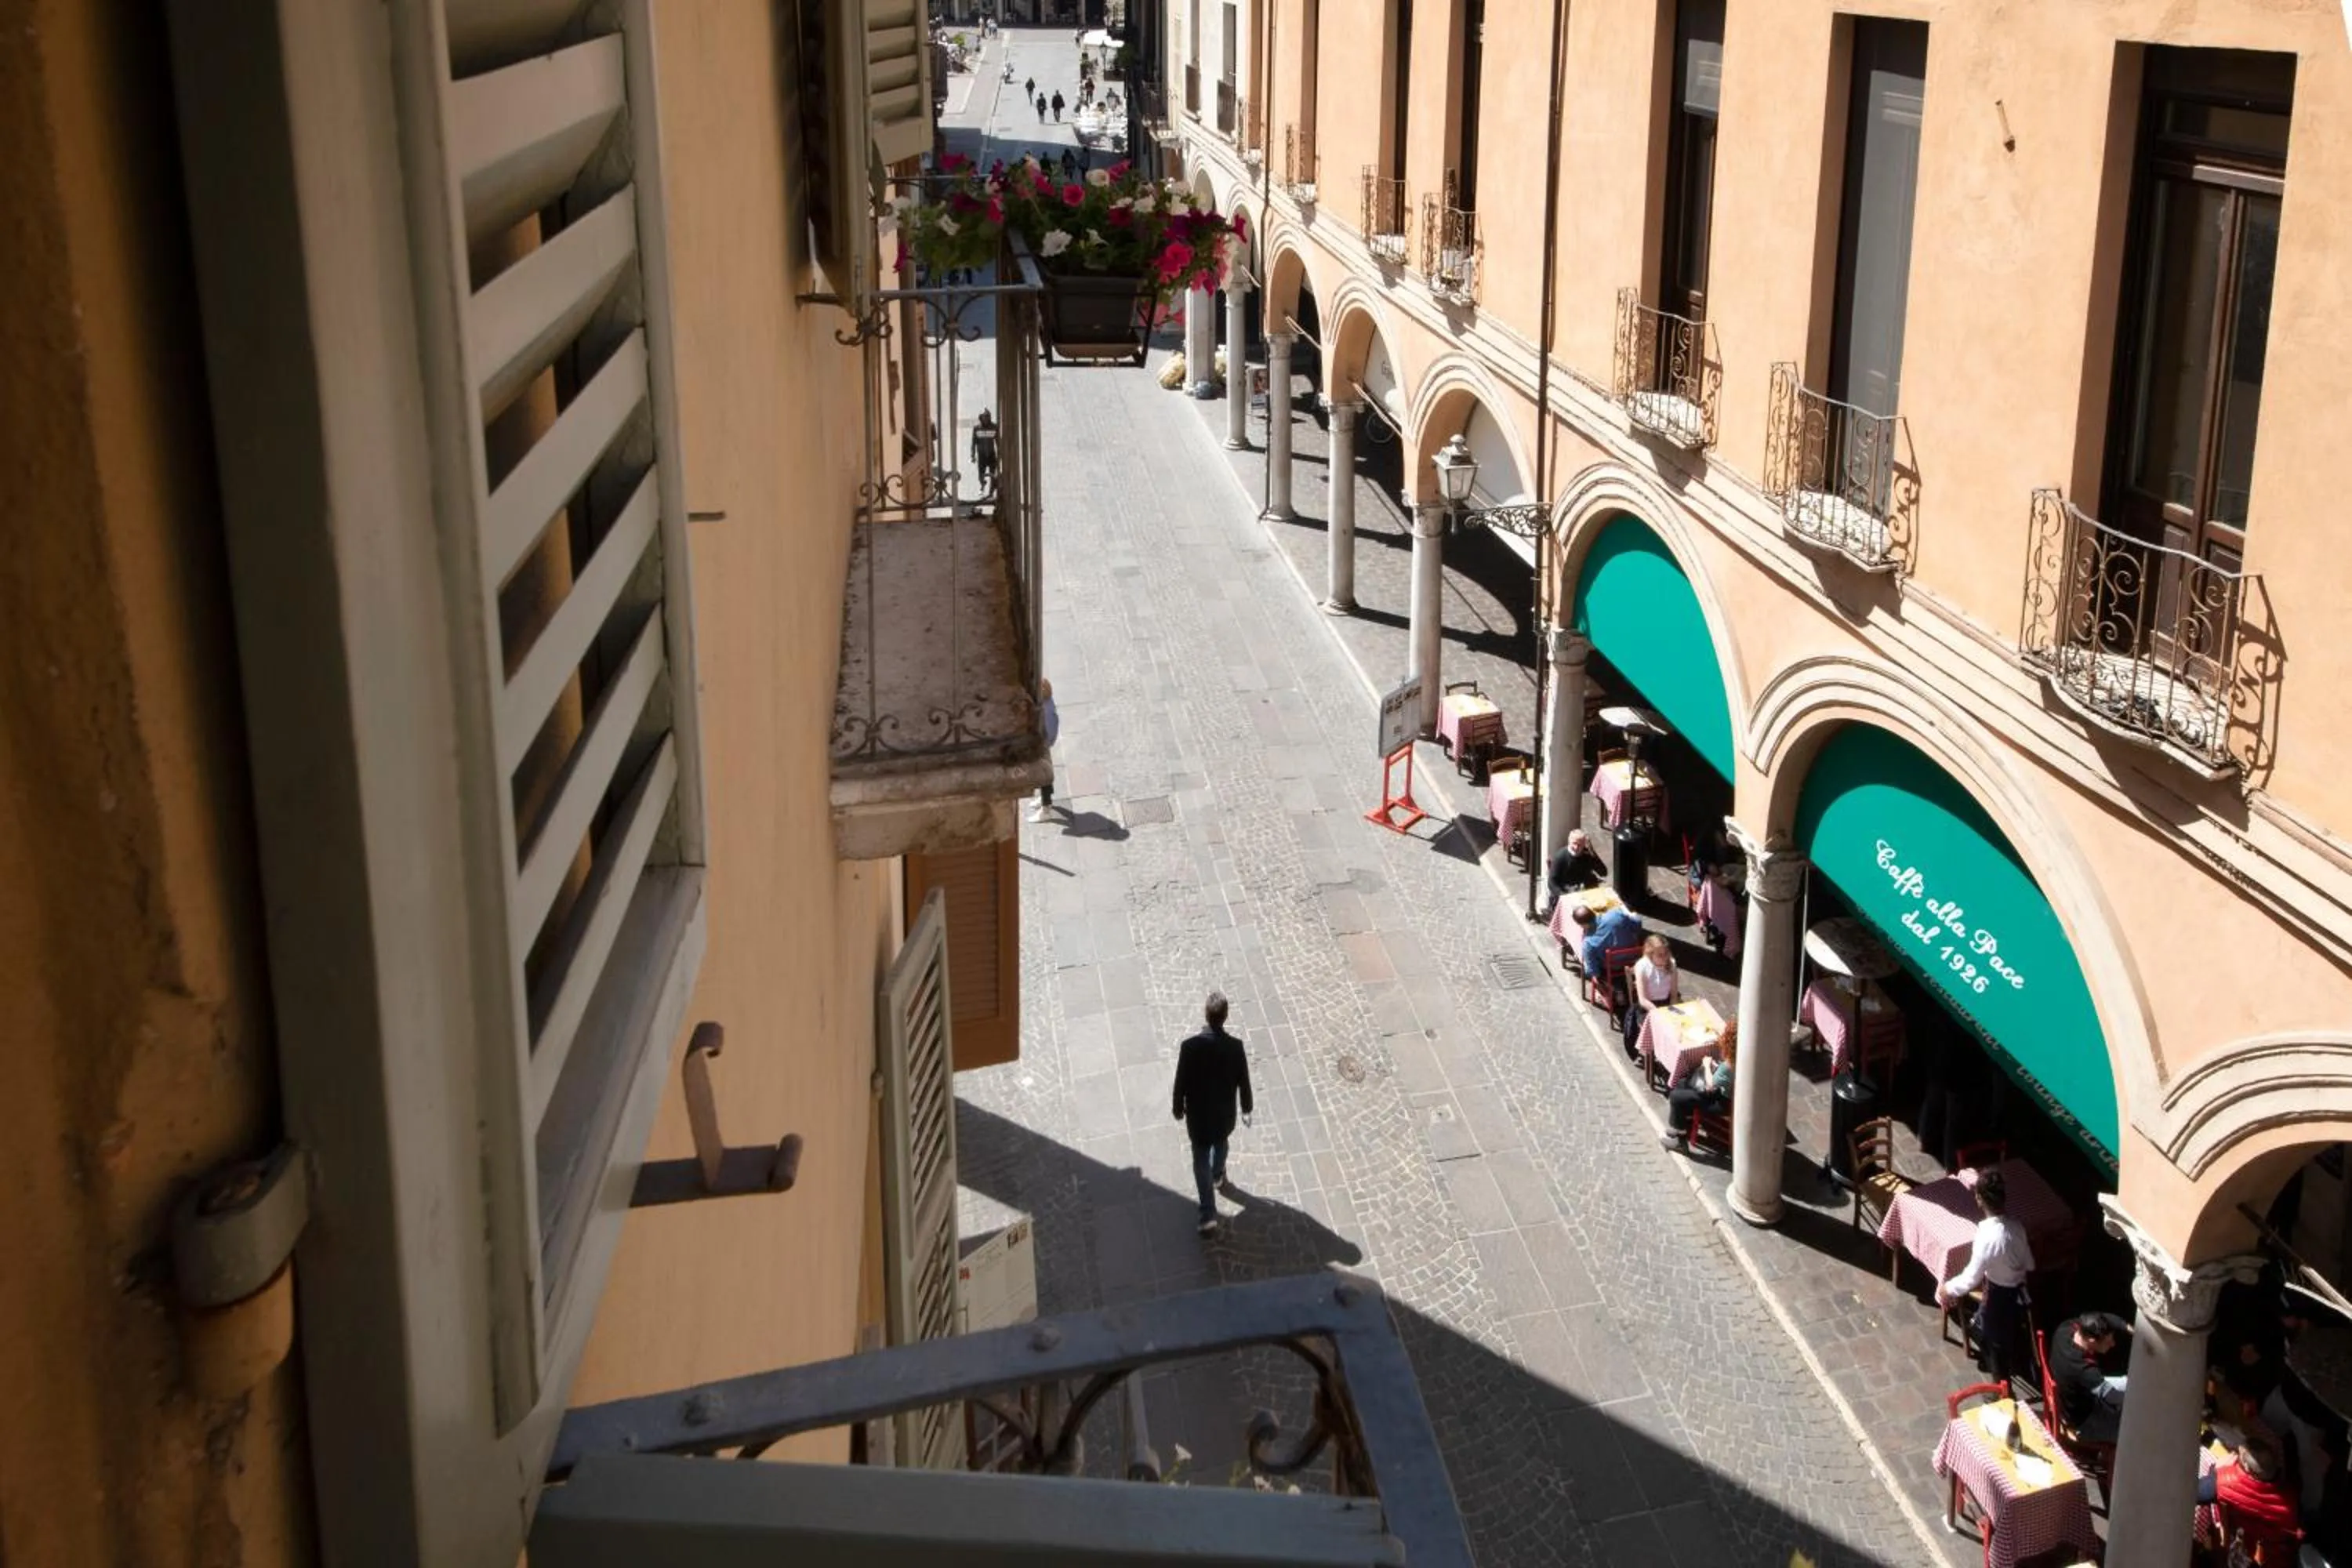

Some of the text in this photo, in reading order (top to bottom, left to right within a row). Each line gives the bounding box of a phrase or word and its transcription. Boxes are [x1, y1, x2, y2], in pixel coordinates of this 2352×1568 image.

[1876, 838, 2025, 989] Caffè alla Pace
[1900, 909, 1941, 946] dal
[1940, 946, 1991, 994] 1926
